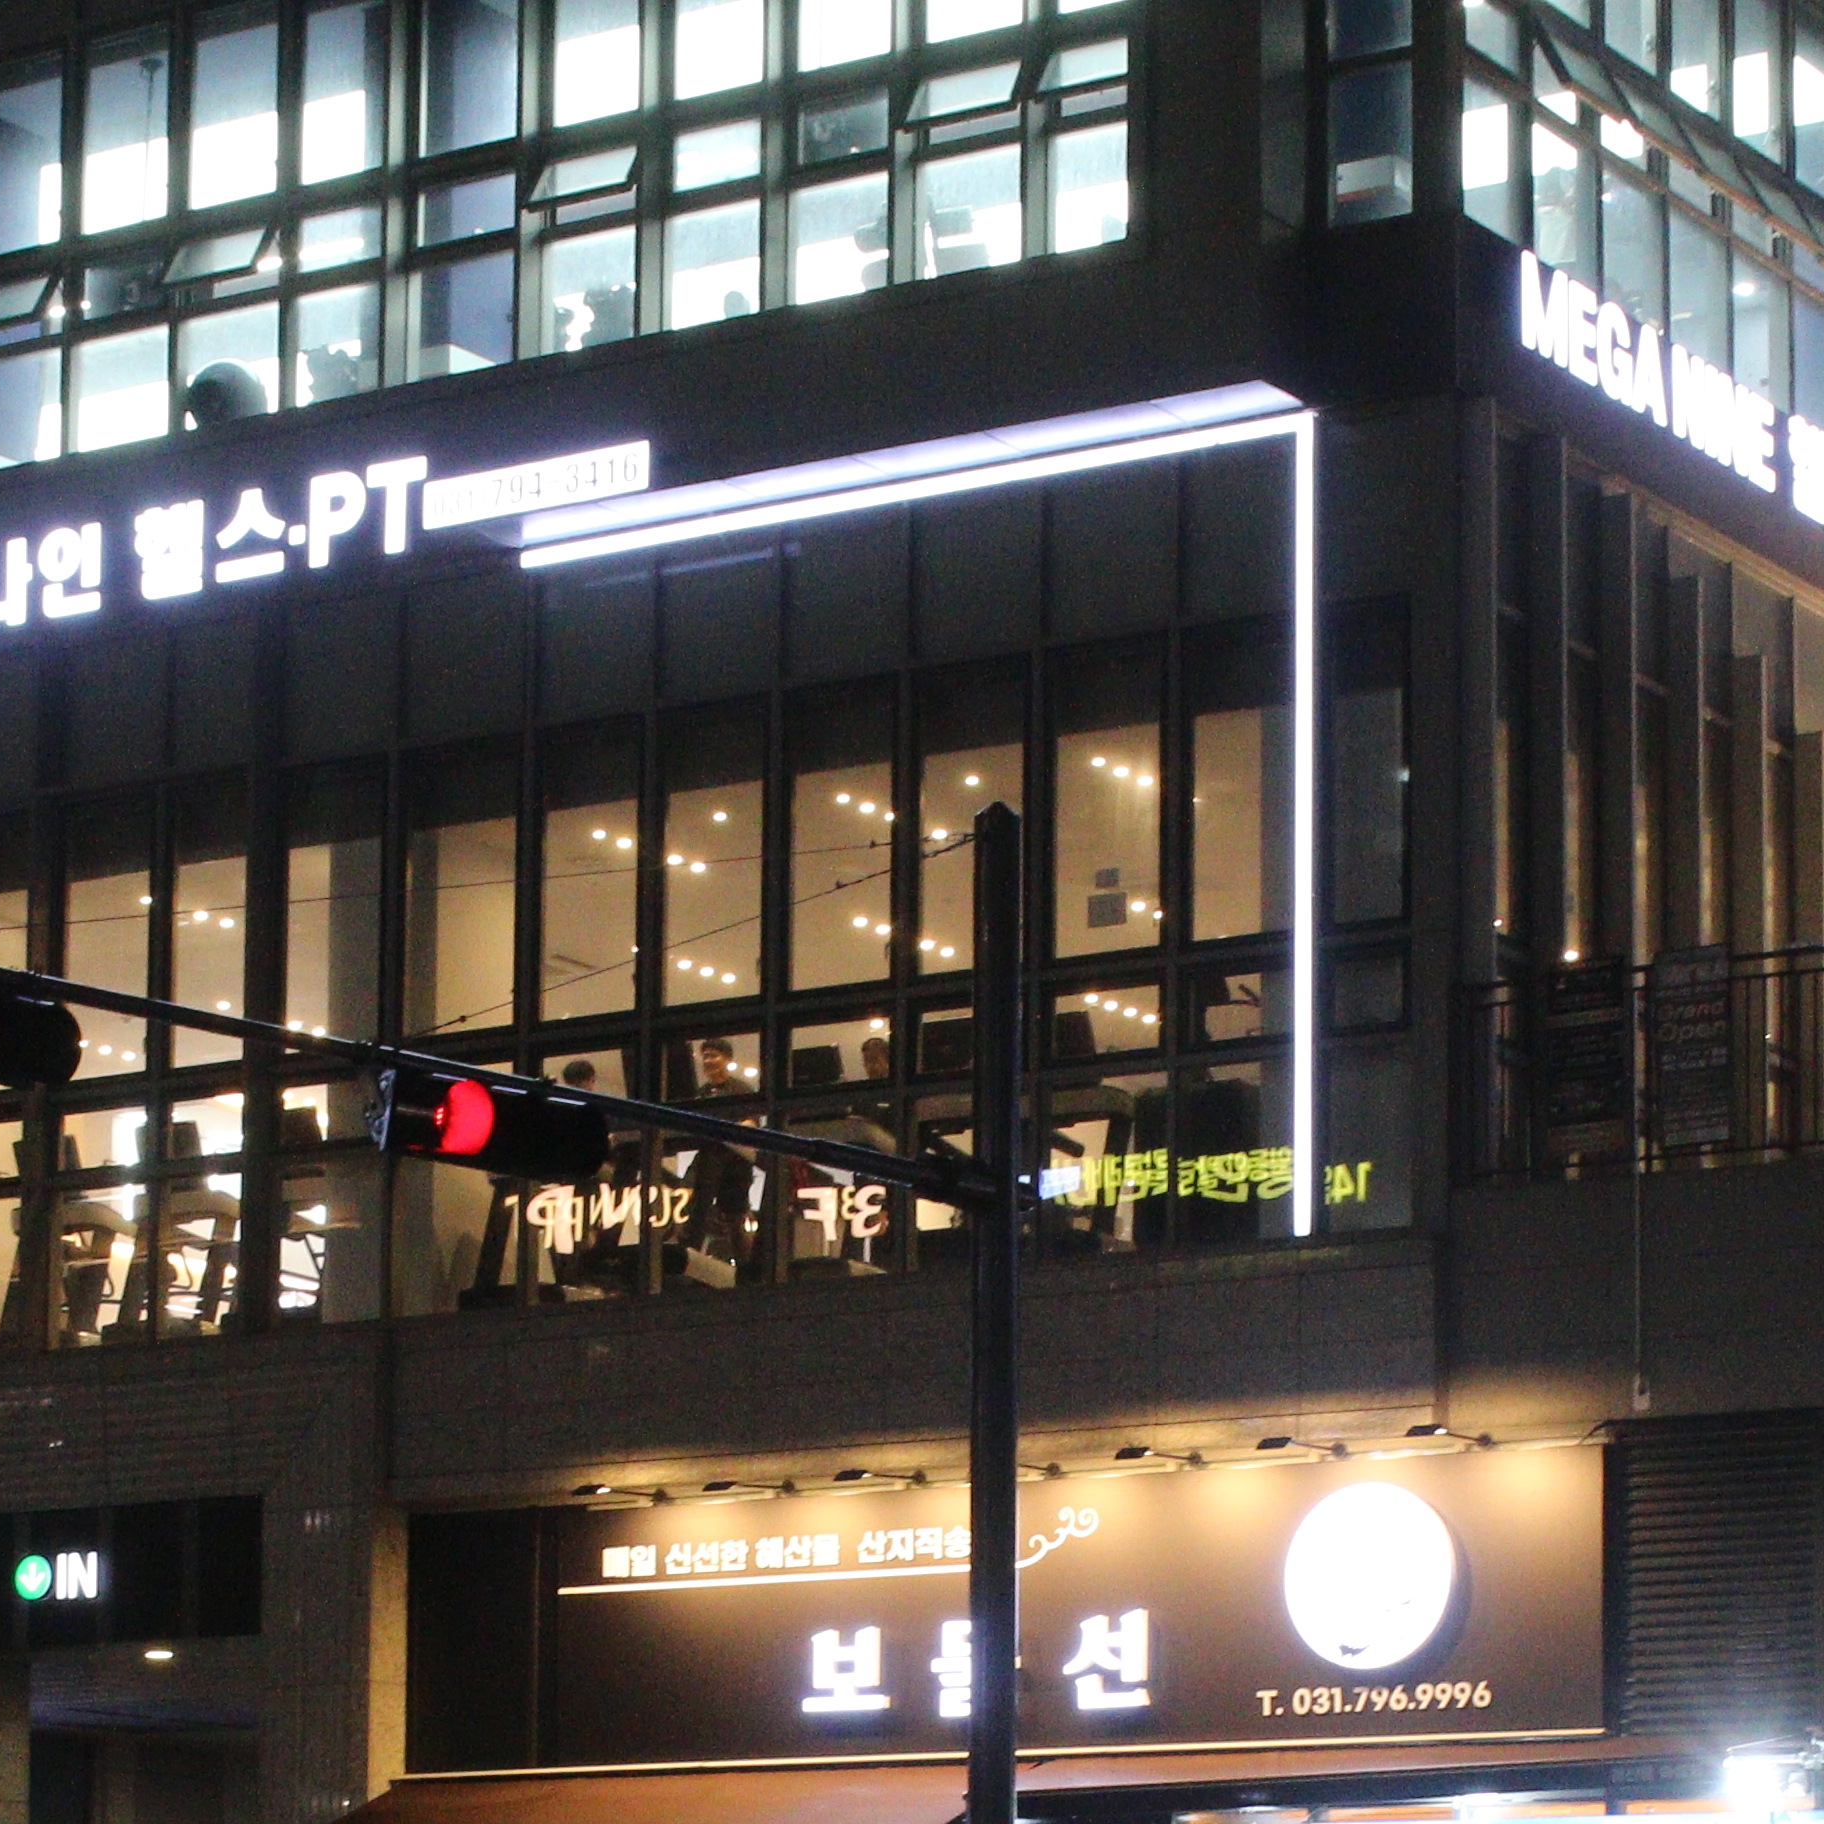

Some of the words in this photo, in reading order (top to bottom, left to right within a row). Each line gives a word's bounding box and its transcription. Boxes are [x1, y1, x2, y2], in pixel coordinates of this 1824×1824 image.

[1521, 250, 1666, 427] MEGA
[664, 1539, 749, 1575] 신선한
[755, 1533, 840, 1570] 해산물
[857, 1525, 972, 1564] 산지직송
[54, 1550, 99, 1601] IN
[1256, 1690, 1284, 1717] T.
[1292, 1680, 1493, 1717] 031.796.9996
